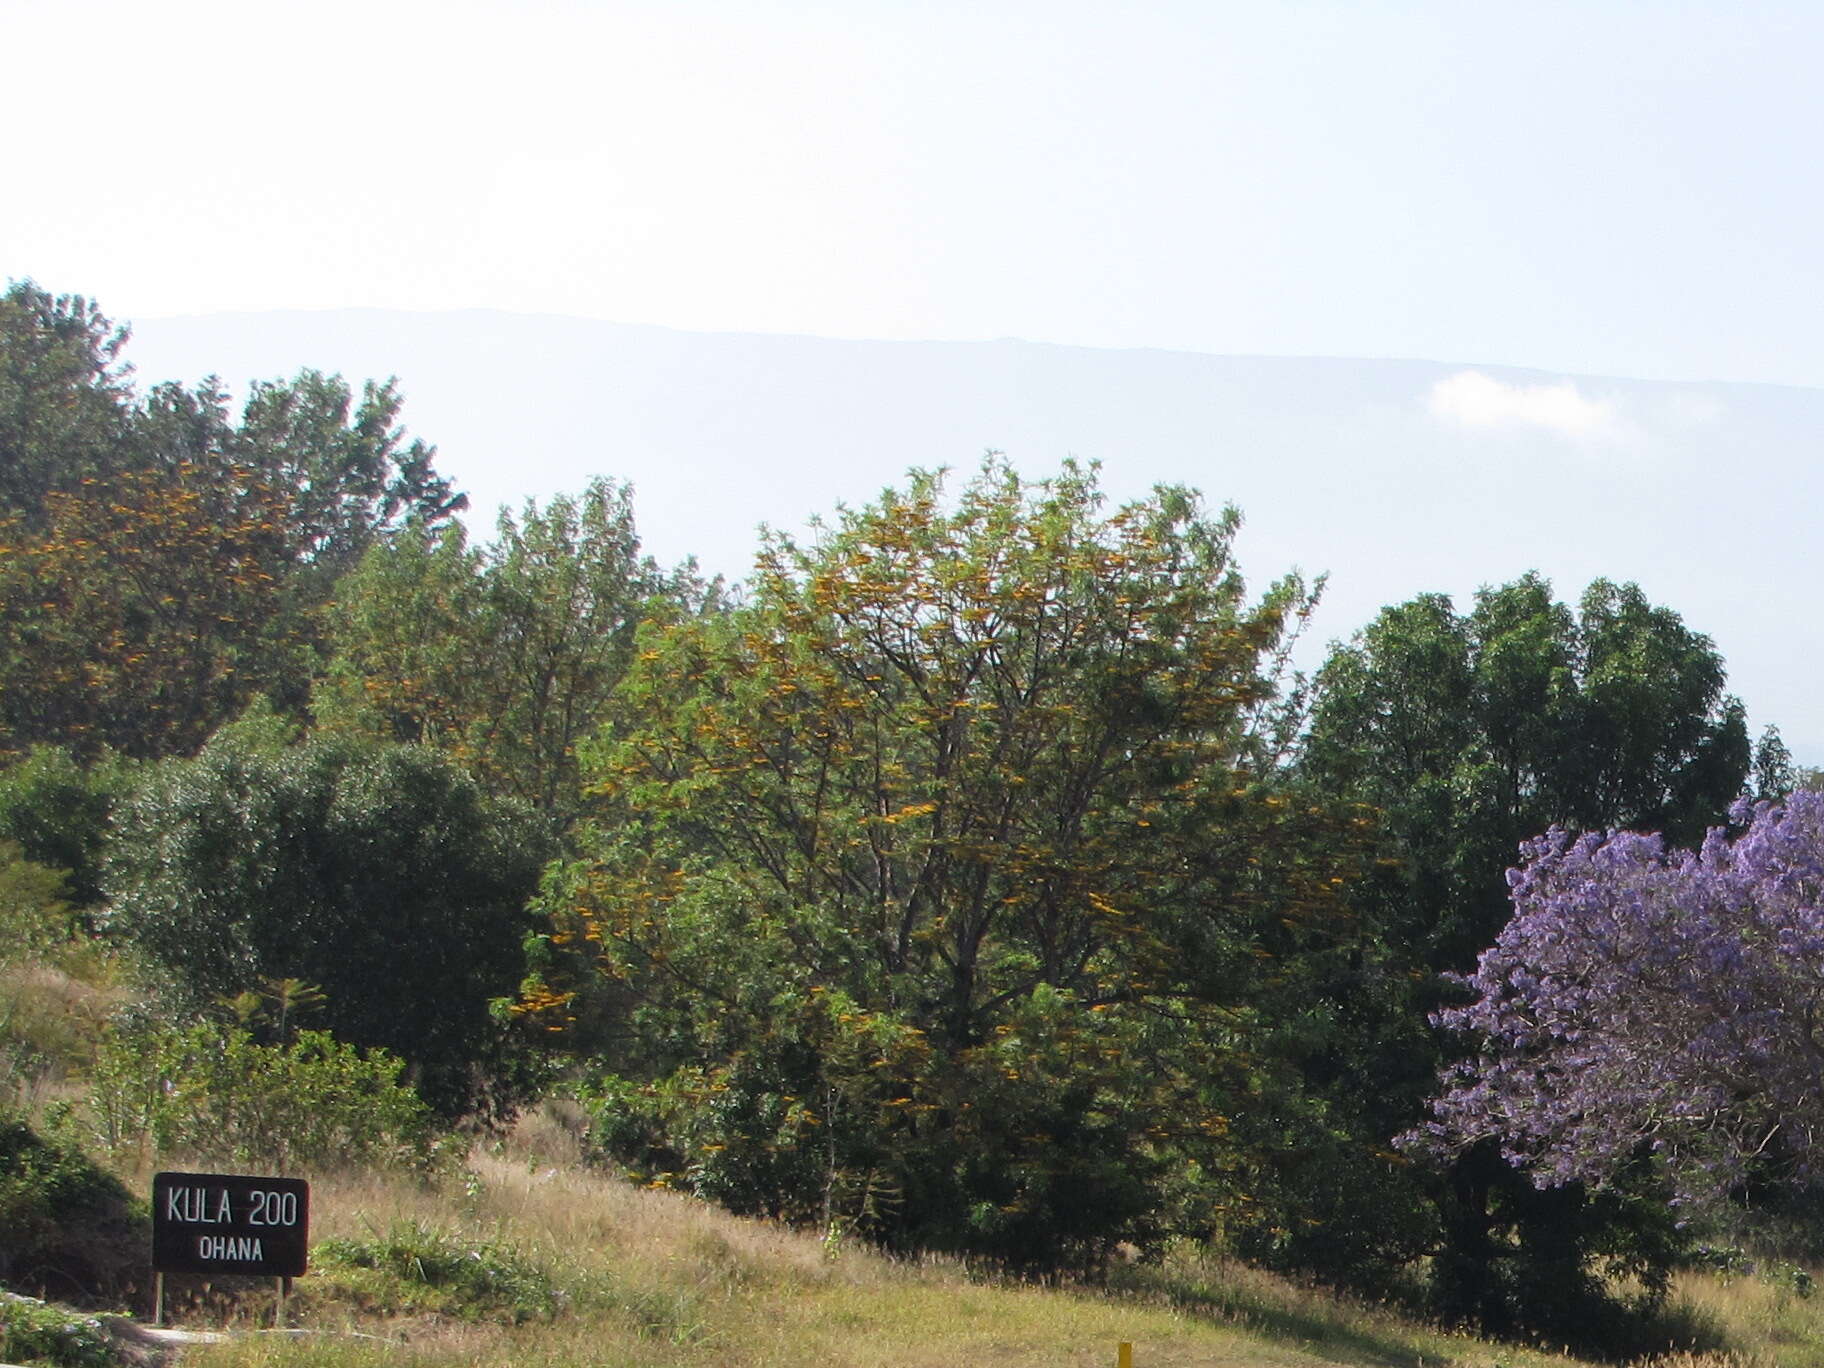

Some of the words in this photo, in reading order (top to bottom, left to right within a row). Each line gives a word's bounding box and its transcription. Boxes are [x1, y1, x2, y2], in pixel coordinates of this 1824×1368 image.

[167, 1186, 232, 1224] KULA
[249, 1190, 298, 1227] 200
[199, 1235, 264, 1262] OHANA
